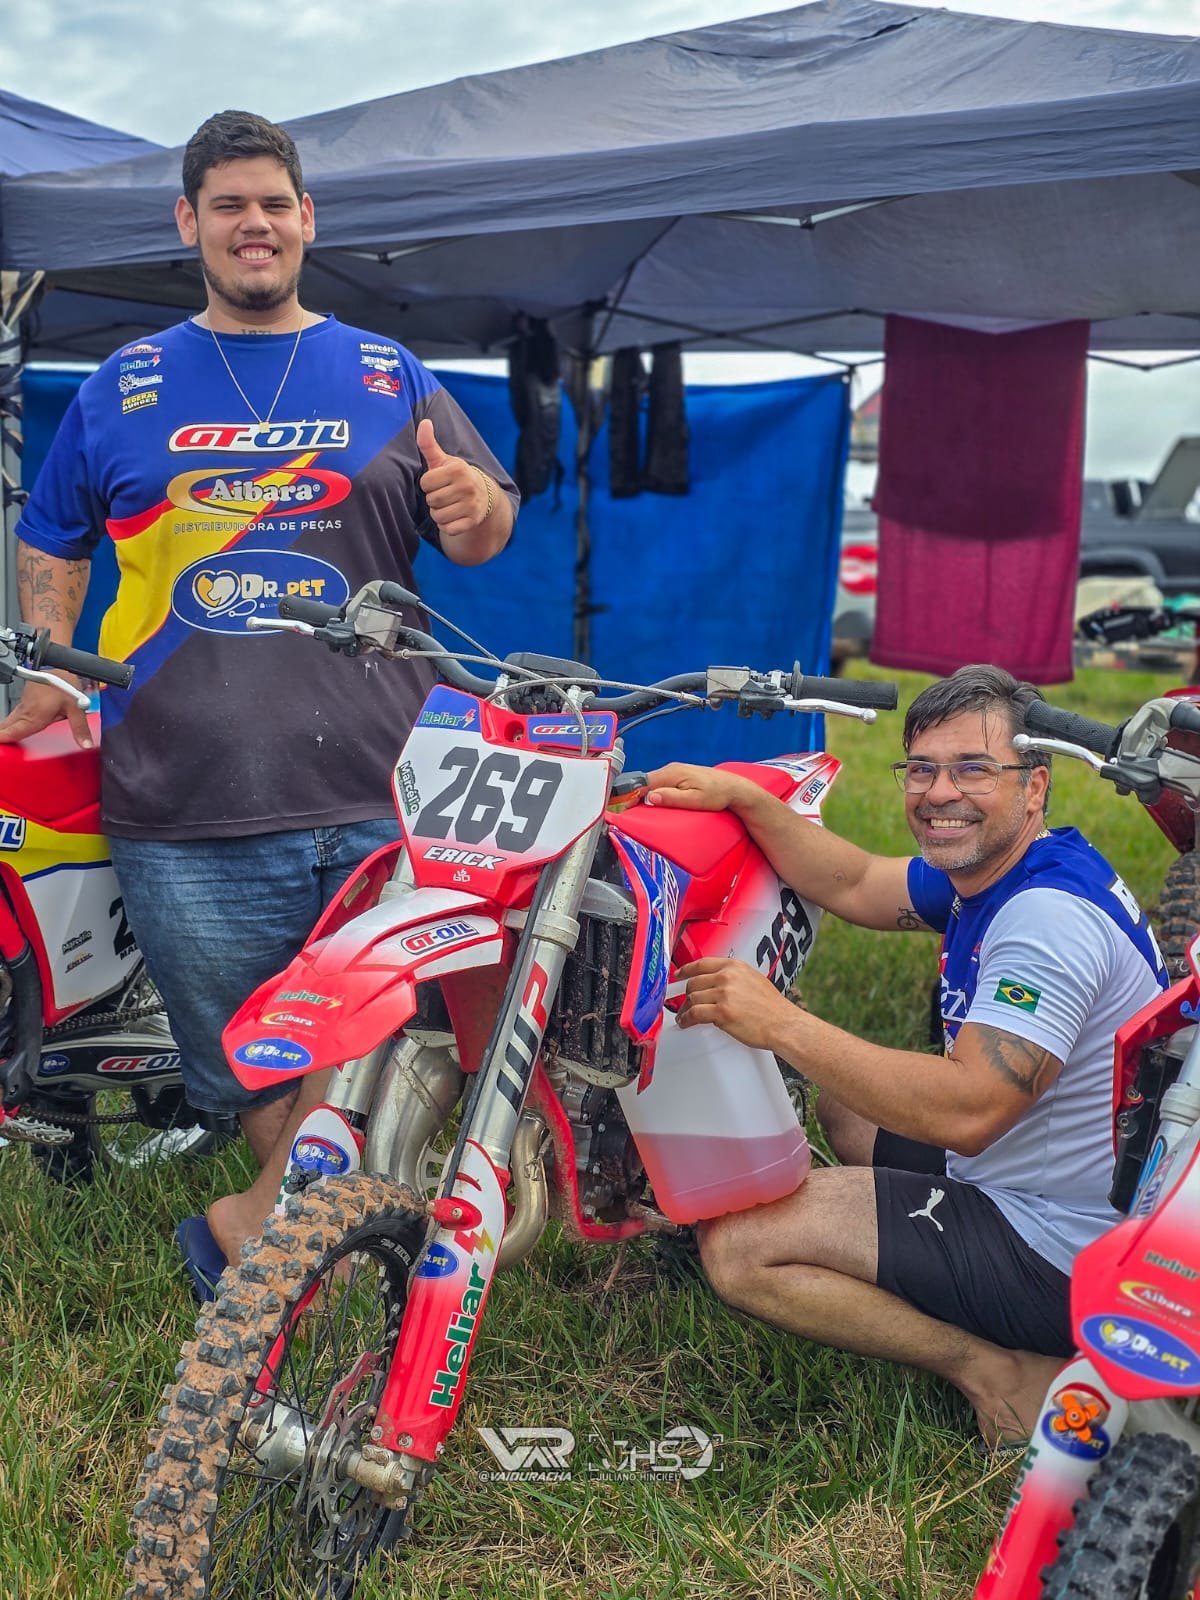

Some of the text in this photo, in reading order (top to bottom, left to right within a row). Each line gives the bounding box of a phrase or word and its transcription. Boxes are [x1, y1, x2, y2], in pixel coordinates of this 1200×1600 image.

[175, 424, 347, 448] GT-OIL
[174, 519, 342, 534] DISTRIBUIDORA DE PEÇAS
[420, 710, 463, 725] Heliar
[535, 725, 606, 735] GT-OL
[412, 746, 563, 853] 269
[802, 781, 823, 804] GT-OIL
[423, 845, 506, 871] ERICK
[405, 922, 475, 951] GT-OIL
[101, 1055, 180, 1070] GT-OI
[428, 1261, 487, 1408] Heliar
